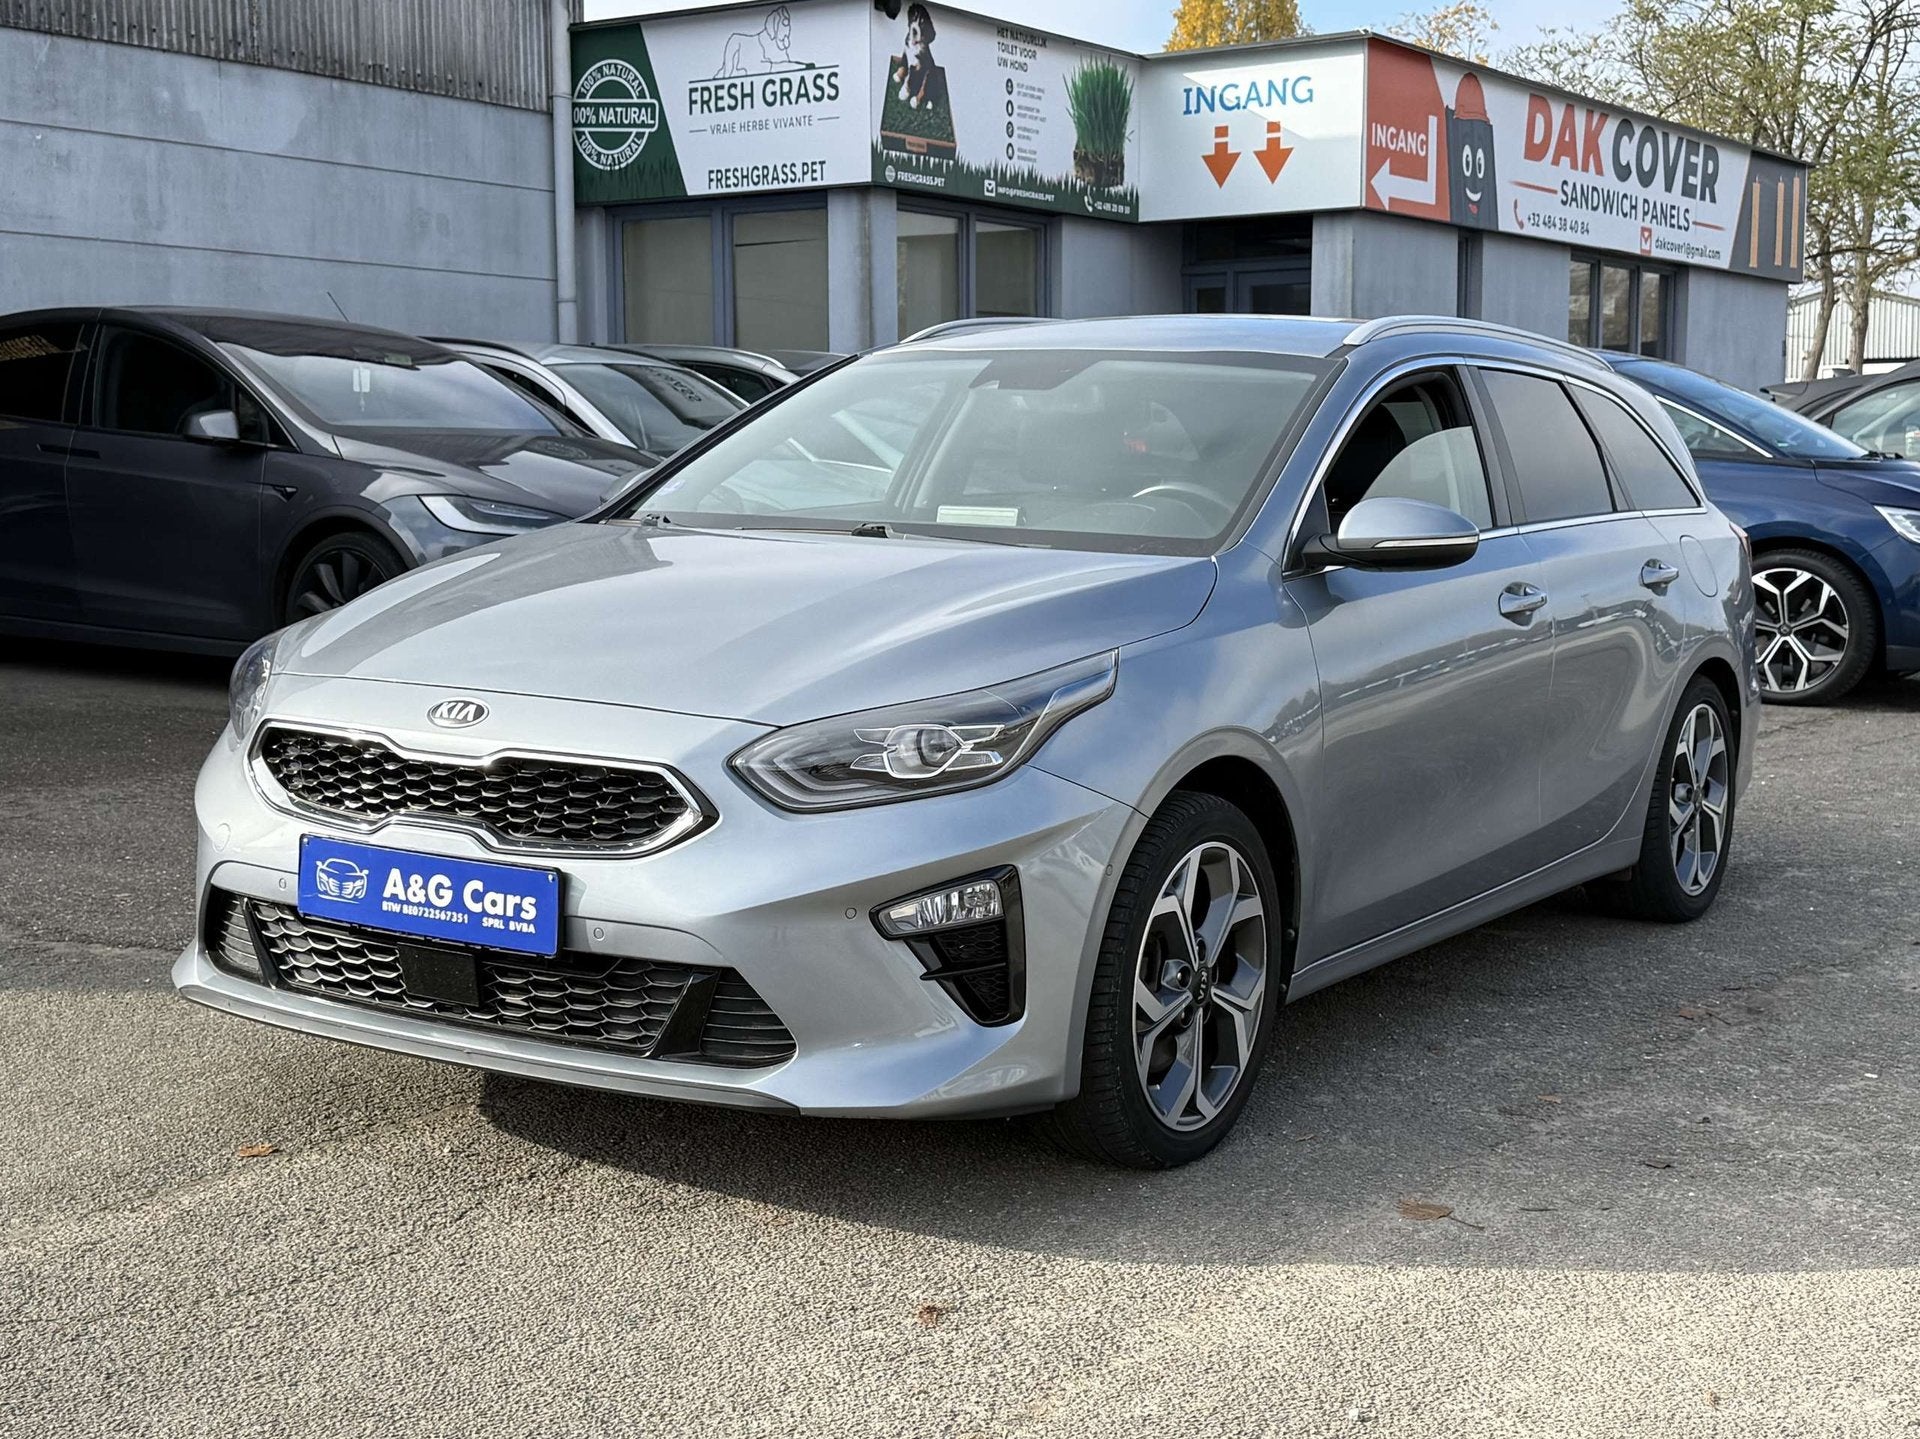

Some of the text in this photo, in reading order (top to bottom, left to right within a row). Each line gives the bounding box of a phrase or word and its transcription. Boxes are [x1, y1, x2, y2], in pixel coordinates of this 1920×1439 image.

[997, 41, 1038, 60] TOILET VOOR
[996, 56, 1029, 73] UW HOND
[580, 63, 644, 96] 100% NATURAL
[688, 71, 840, 116] FRESH GRASS
[1182, 75, 1314, 116] INGANG
[573, 106, 656, 124] 00% NATURAL
[710, 115, 814, 135] VRAIE HERBE VIVANTE
[579, 134, 644, 166] 100% NATURAL
[1371, 121, 1428, 157] INGANG
[708, 160, 827, 190] FRESHGRASS.PET
[1560, 179, 1690, 232] SANDWICH PANELS
[1527, 212, 1590, 236] +32 484 38 40 84
[434, 701, 477, 722] KIA
[381, 900, 401, 914] BTW
[382, 867, 538, 921] A&G Cars
[481, 916, 536, 935] SPRL BVBA
